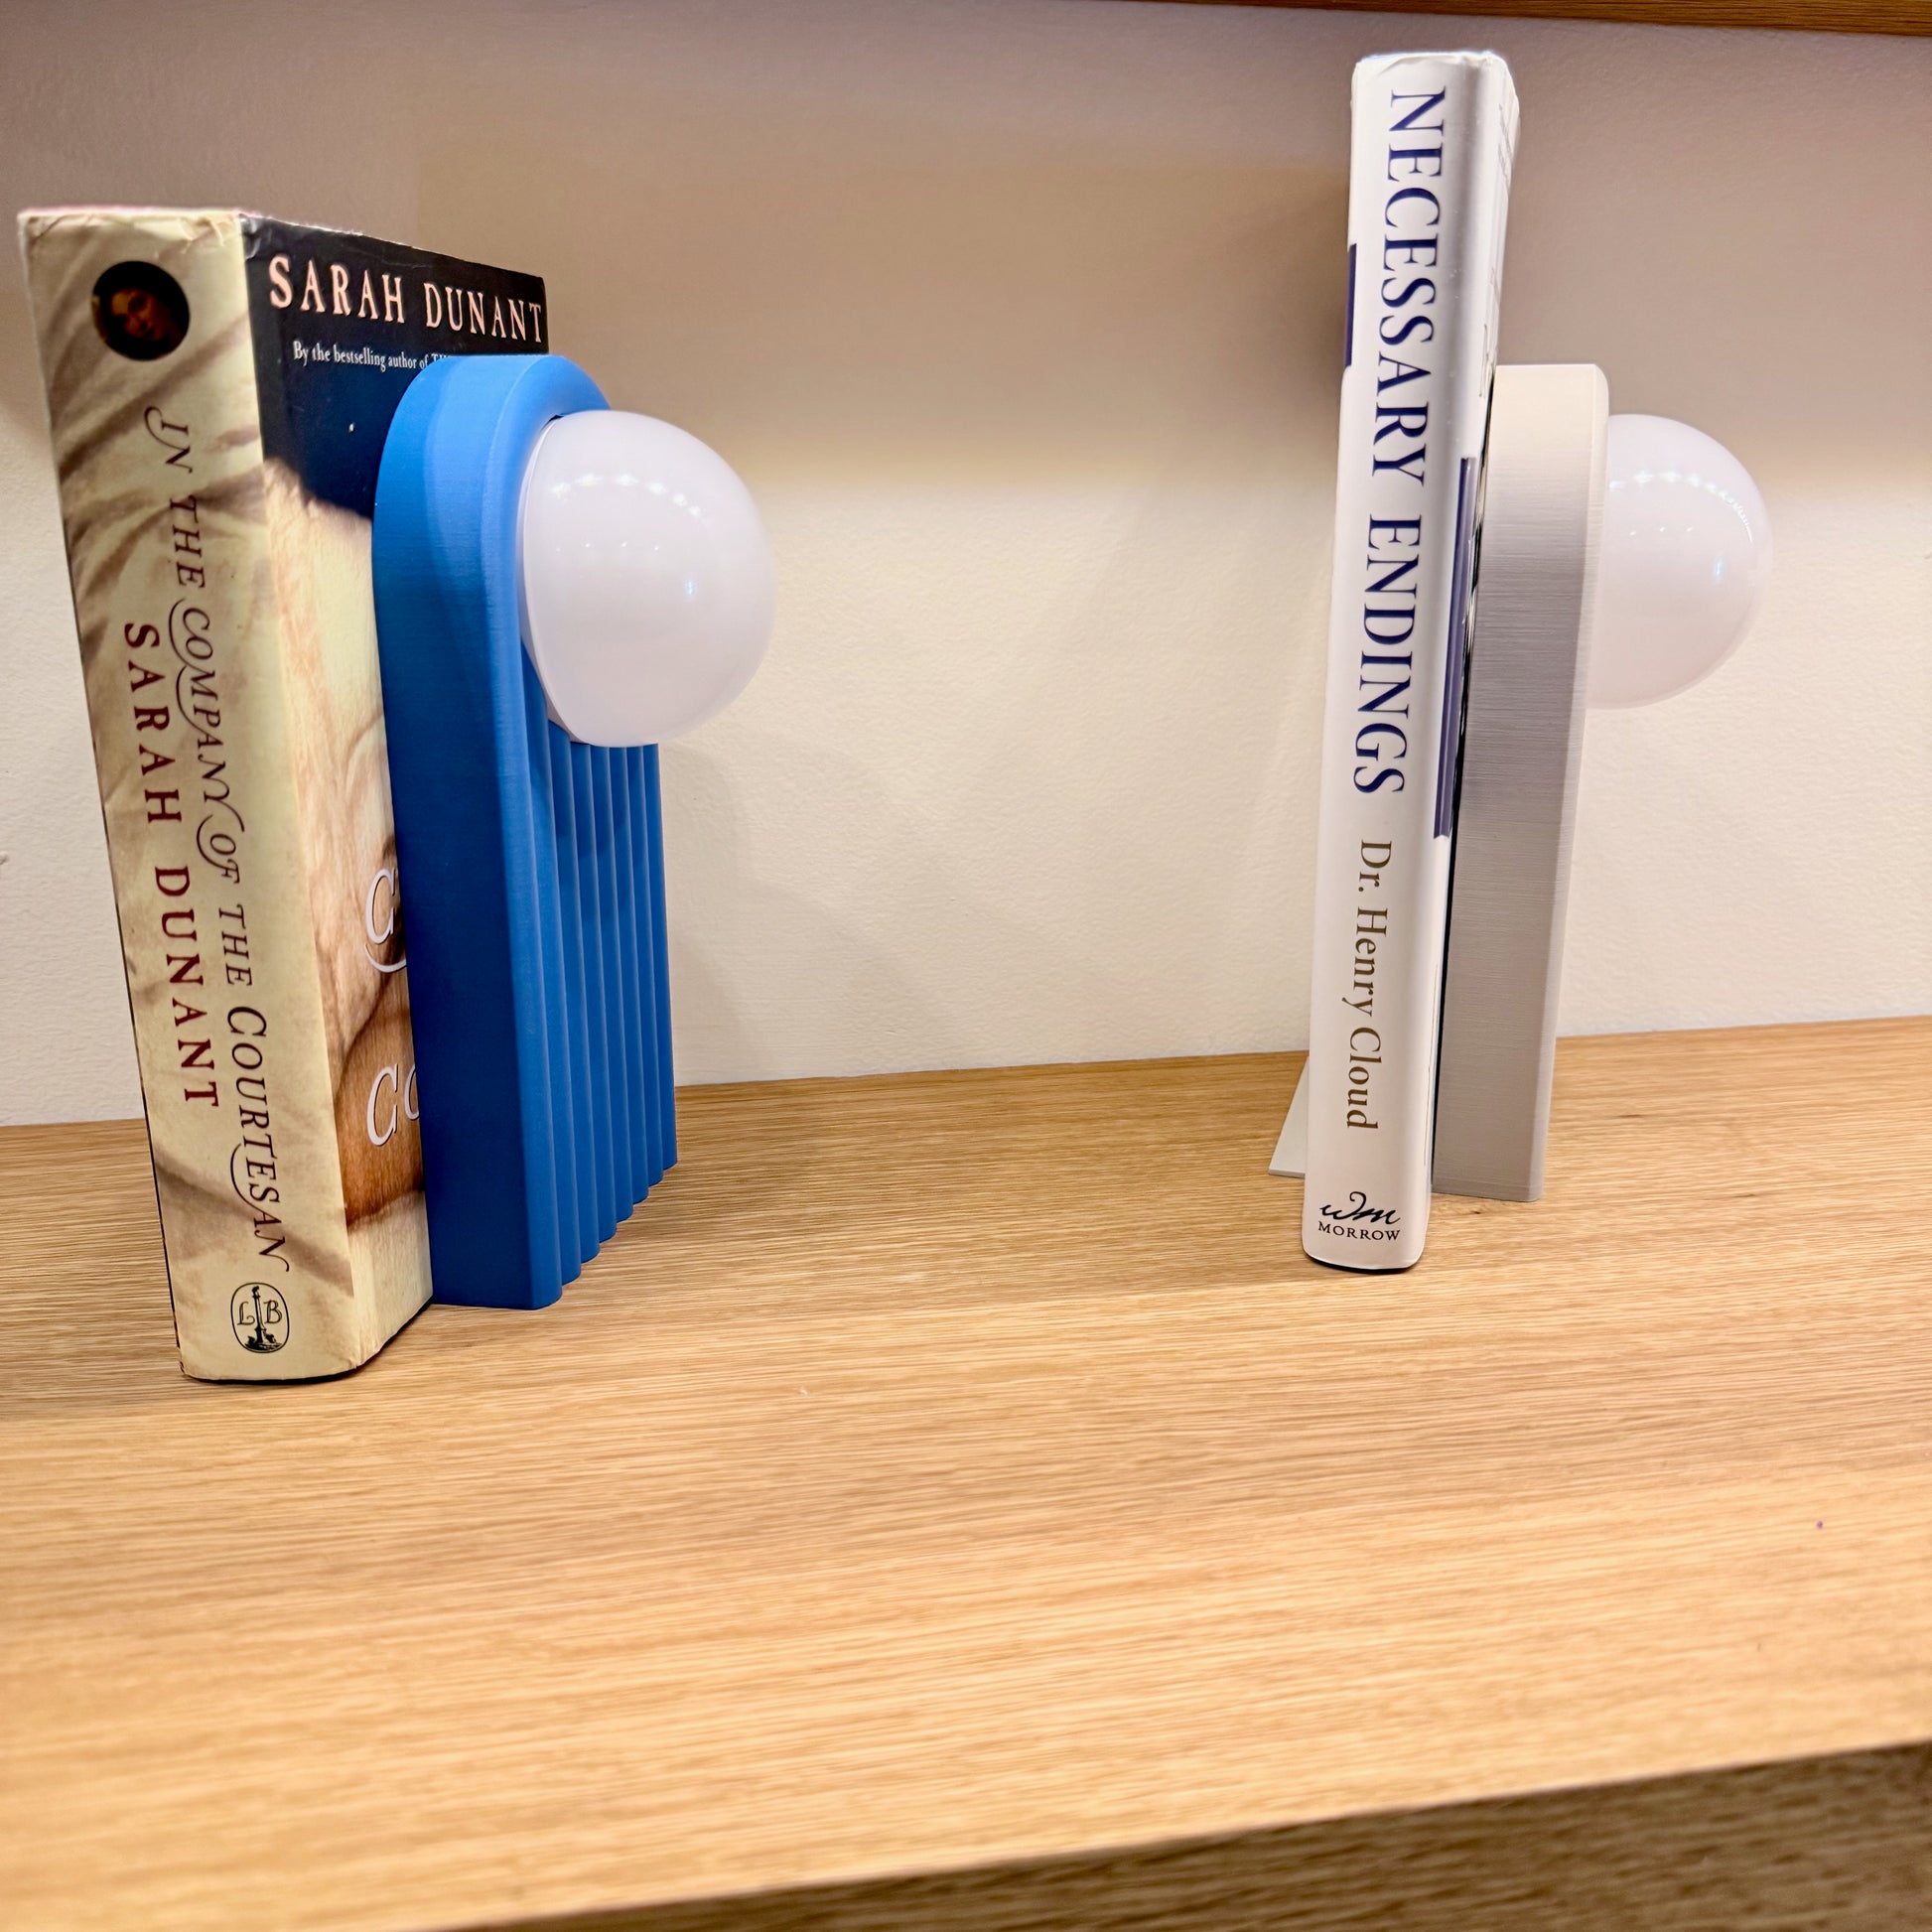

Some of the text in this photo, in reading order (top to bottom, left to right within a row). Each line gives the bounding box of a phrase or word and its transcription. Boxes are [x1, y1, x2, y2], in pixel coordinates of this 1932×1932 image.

[268, 253, 543, 344] SARAH DUNANT
[292, 341, 309, 367] By
[312, 343, 331, 363] the
[333, 345, 387, 373] bestselling
[388, 351, 417, 369] author
[1352, 84, 1447, 794] NECESSARY ENDINGS
[124, 622, 219, 1108] SARAH DUNANT
[144, 405, 290, 1273] IN THE COMPANY OF THE COURTESAN
[1341, 839, 1393, 1131] Dr. Henry Cloud
[1317, 1221, 1401, 1241] MORROW
